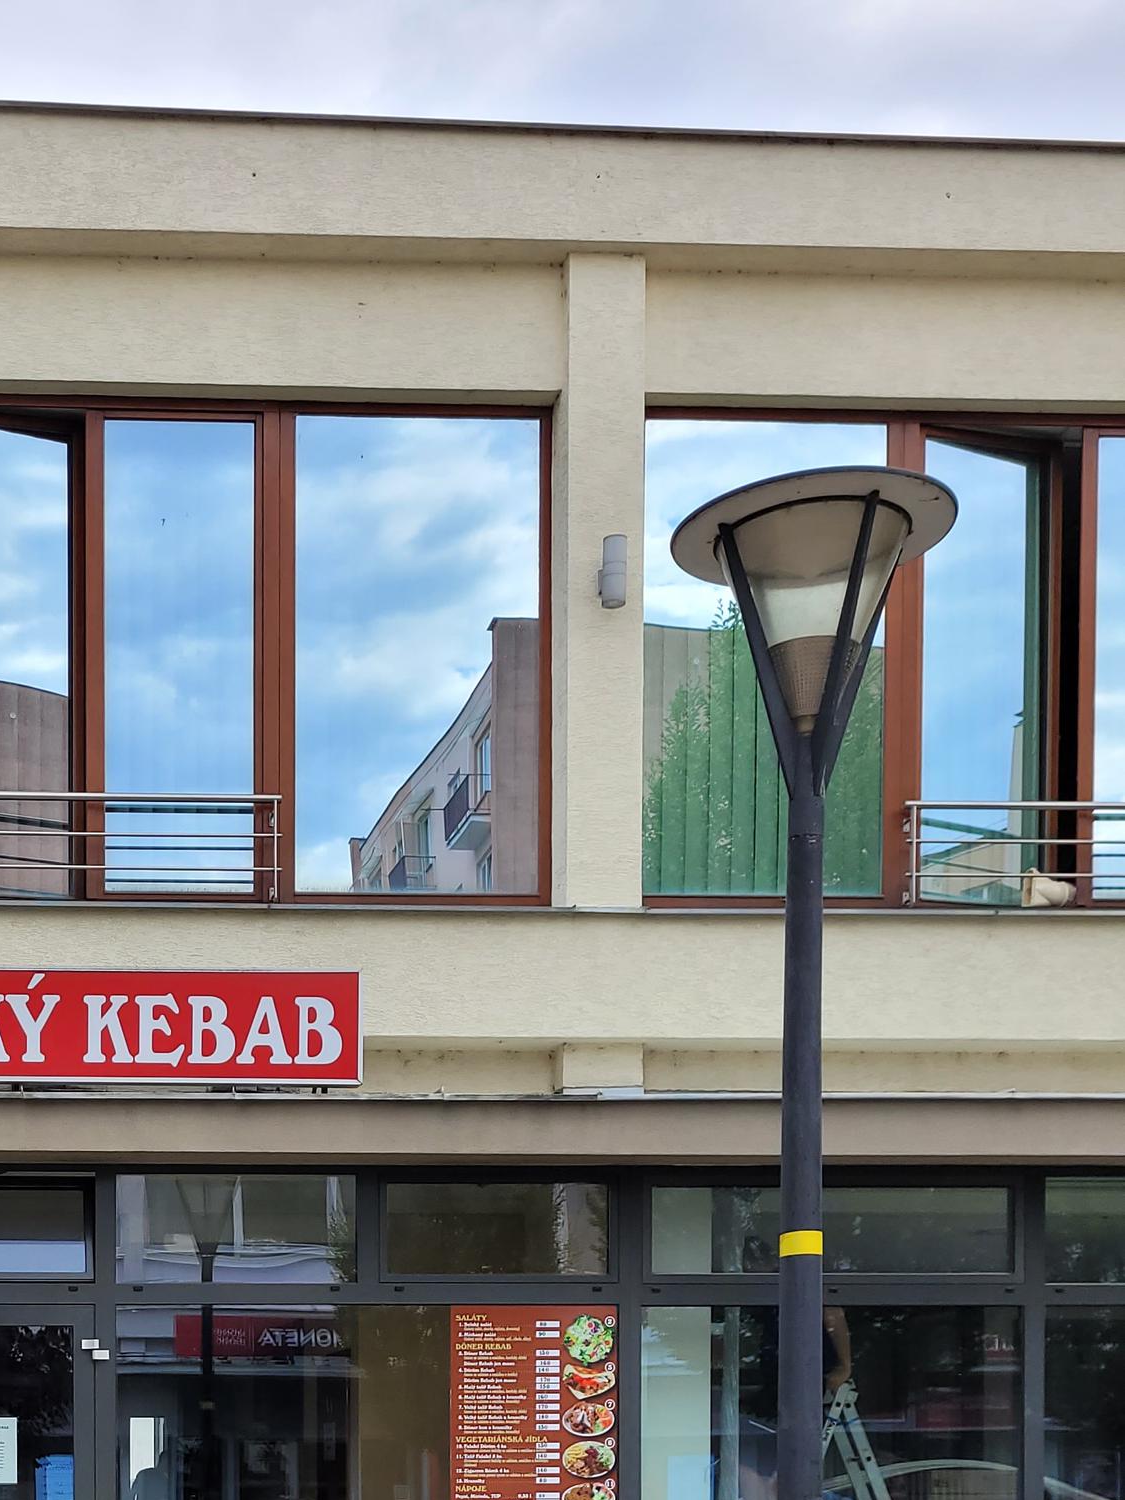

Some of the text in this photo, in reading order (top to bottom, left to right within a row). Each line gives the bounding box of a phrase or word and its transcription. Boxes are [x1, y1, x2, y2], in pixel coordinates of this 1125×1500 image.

[82, 993, 343, 1067] KEBAB
[455, 1435, 548, 1443] VEGETARIÁNSKÁ JÍDLA
[455, 1484, 487, 1492] NÁPOJE
